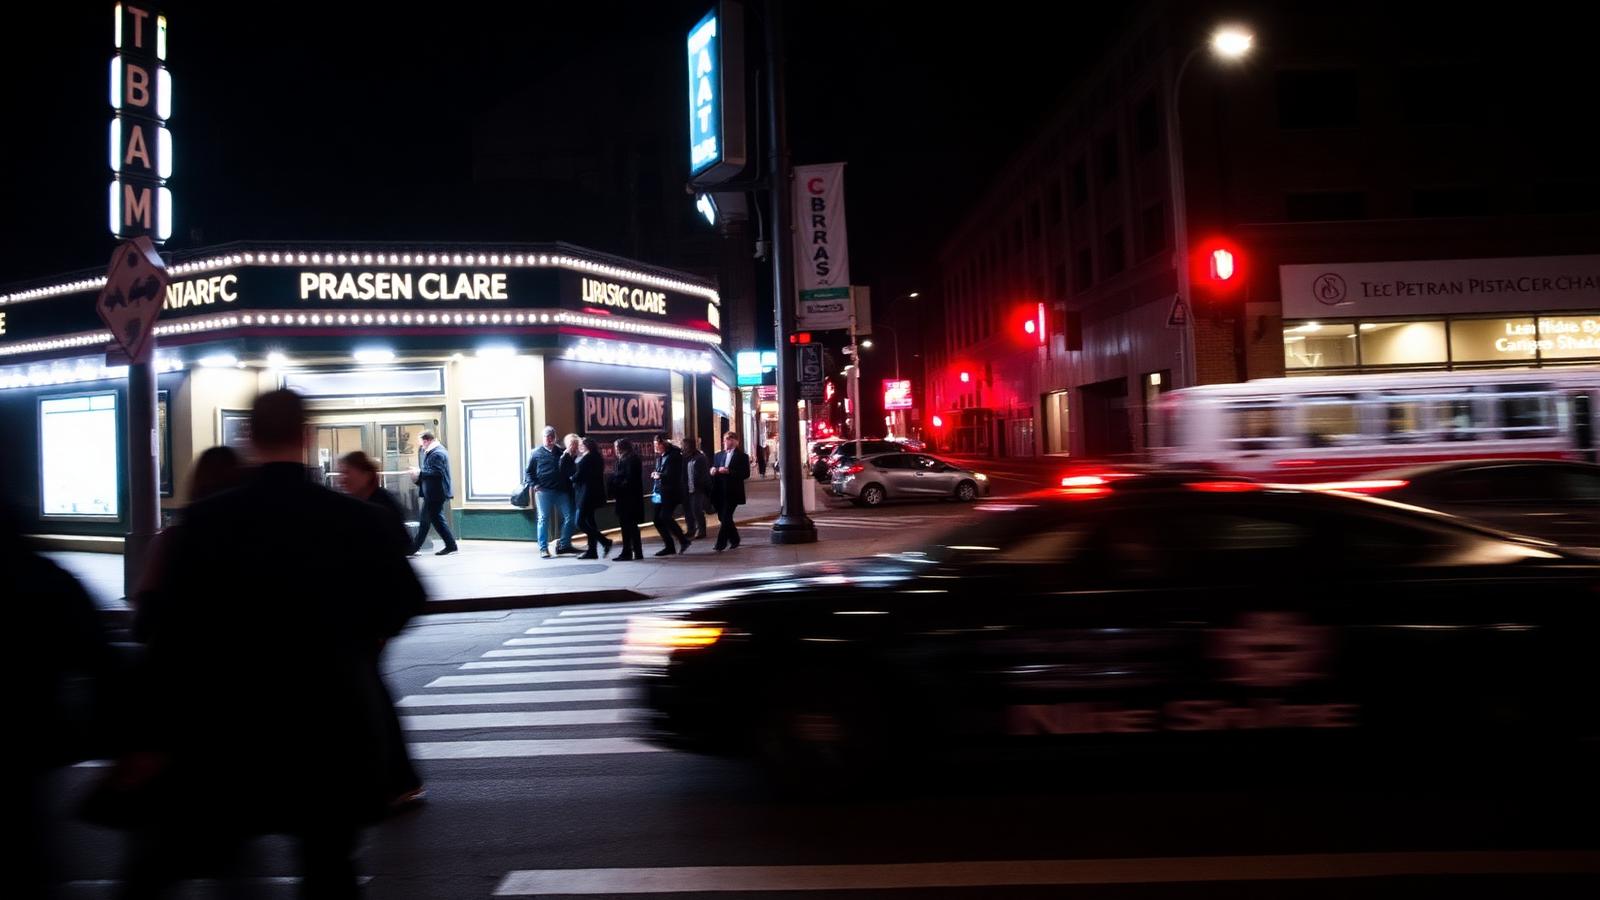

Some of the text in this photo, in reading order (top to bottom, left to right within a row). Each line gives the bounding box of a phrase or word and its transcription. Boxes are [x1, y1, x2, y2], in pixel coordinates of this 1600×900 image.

[124, 6, 152, 229] TBAM
[808, 178, 829, 277] CBRRAS
[300, 272, 508, 301] PRASEN CLARE
[1396, 280, 1463, 297] PETRAN
